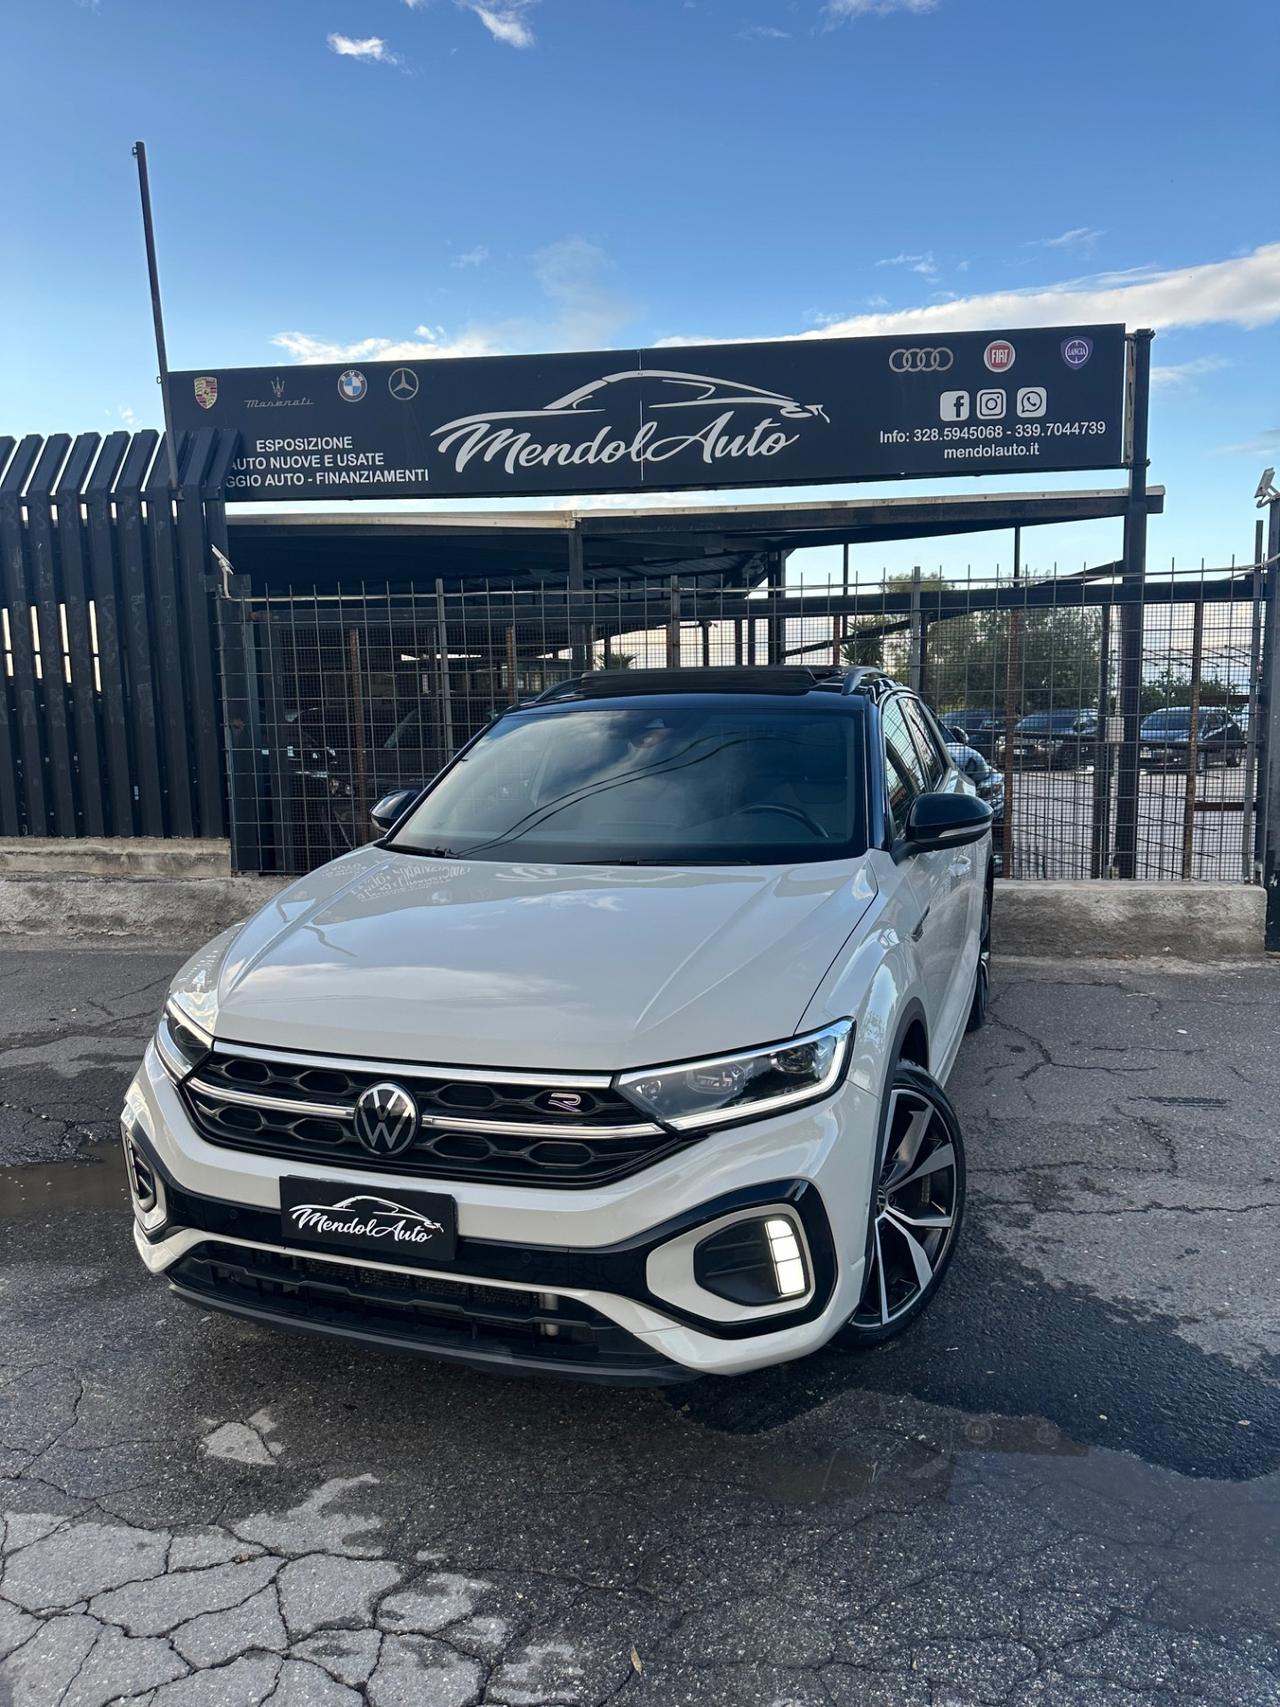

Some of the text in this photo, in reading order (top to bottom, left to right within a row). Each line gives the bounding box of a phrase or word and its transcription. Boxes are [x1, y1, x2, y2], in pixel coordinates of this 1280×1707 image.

[991, 349, 1010, 365] FIAT
[880, 431, 909, 443] Info:
[913, 425, 1003, 442] 328.5945068
[1015, 421, 1106, 438] 339.7044739
[256, 437, 353, 452] ESPOSIZIONE
[944, 443, 1040, 459] mendolauto.it
[270, 454, 321, 469] NUOVE
[324, 454, 333, 467] E
[336, 452, 384, 467] USATE
[264, 472, 305, 487] AUTO
[316, 468, 429, 484] FINANZIAMENTI
